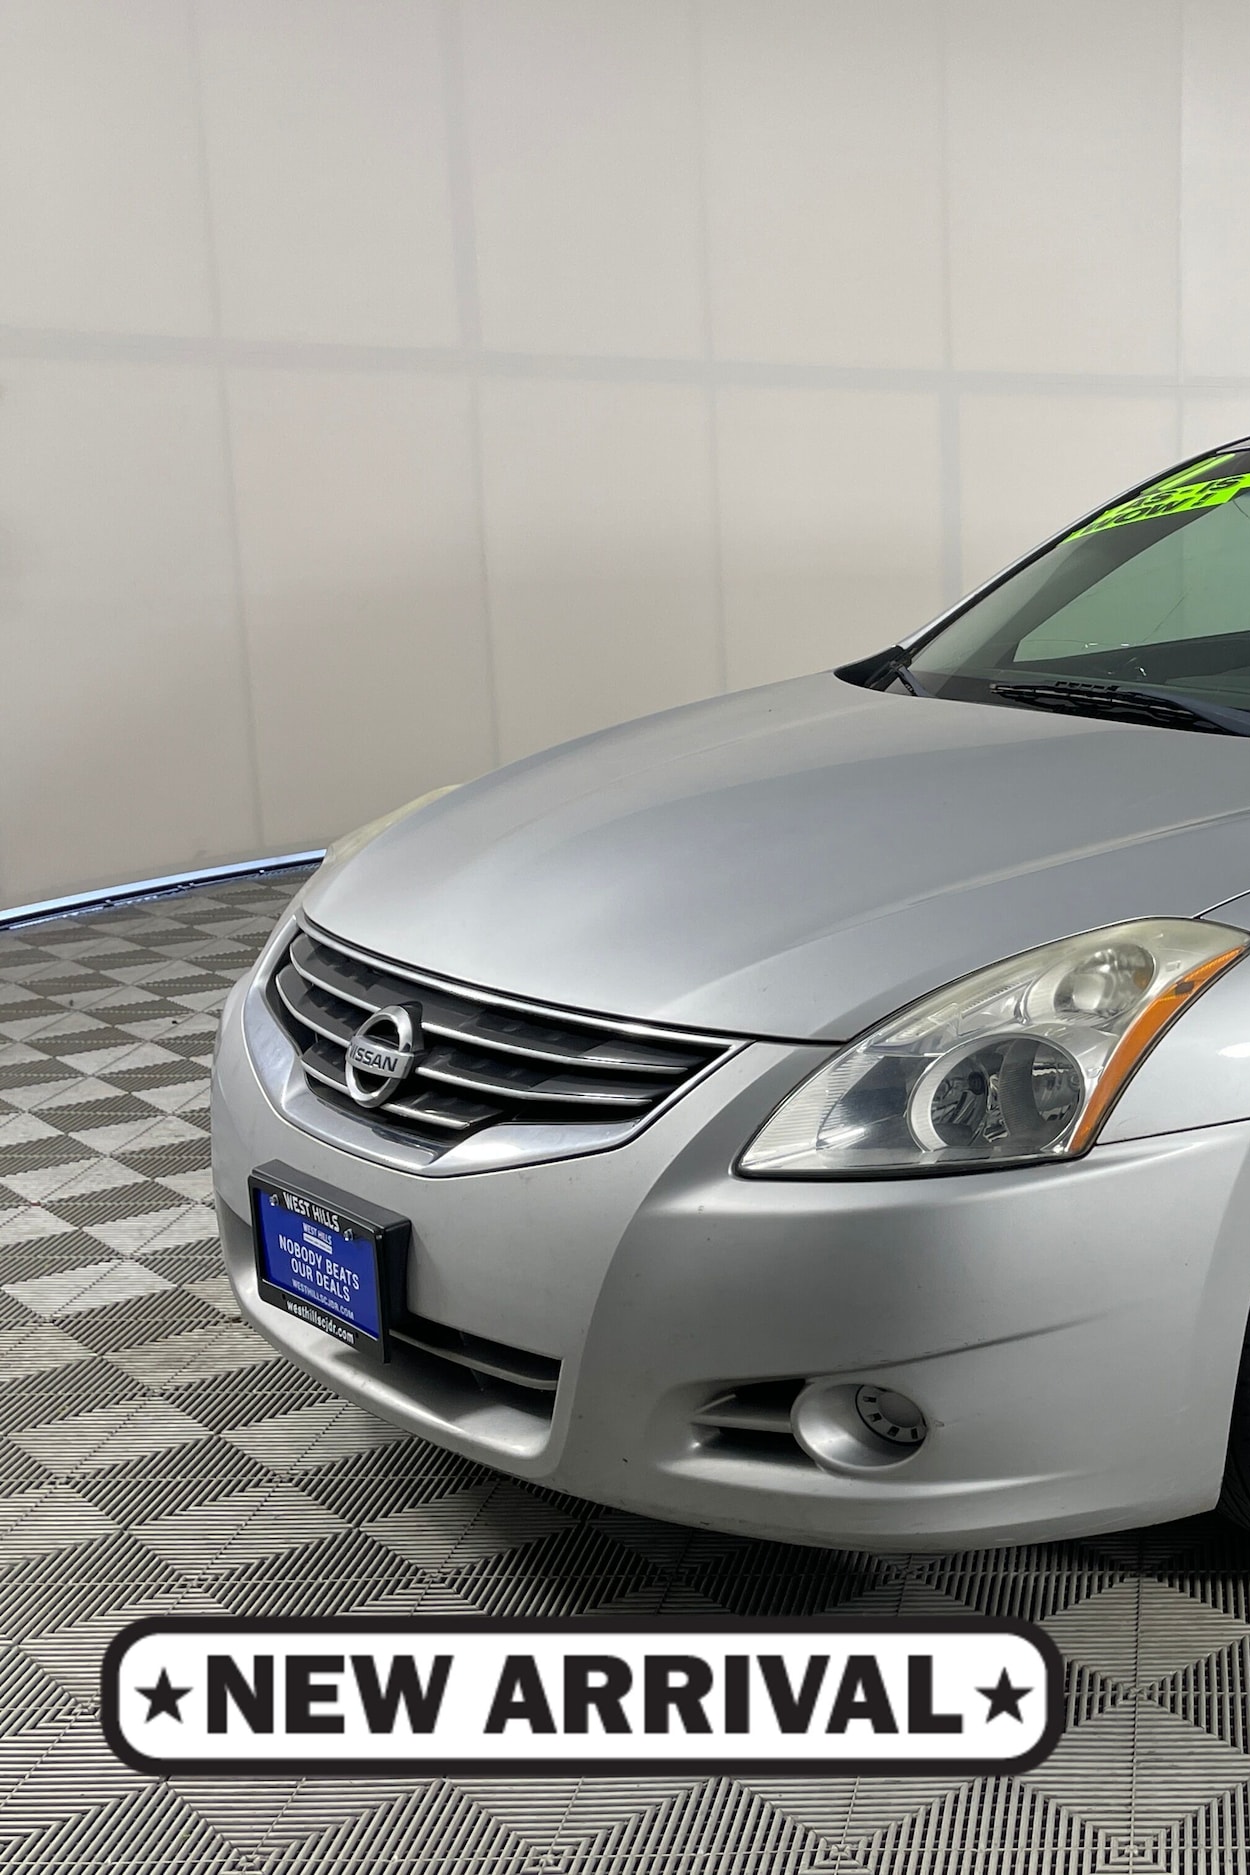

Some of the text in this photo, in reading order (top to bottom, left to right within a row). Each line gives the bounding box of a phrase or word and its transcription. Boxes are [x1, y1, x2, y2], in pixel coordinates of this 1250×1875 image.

[283, 1191, 340, 1233] WEST HILLS
[303, 1222, 317, 1236] WEST
[318, 1230, 333, 1245] HILLS
[279, 1234, 323, 1269] NOBODY
[325, 1259, 360, 1290] BEATS
[291, 1258, 350, 1302] OUR DEALS
[286, 1300, 355, 1345] westhillscjdr.com
